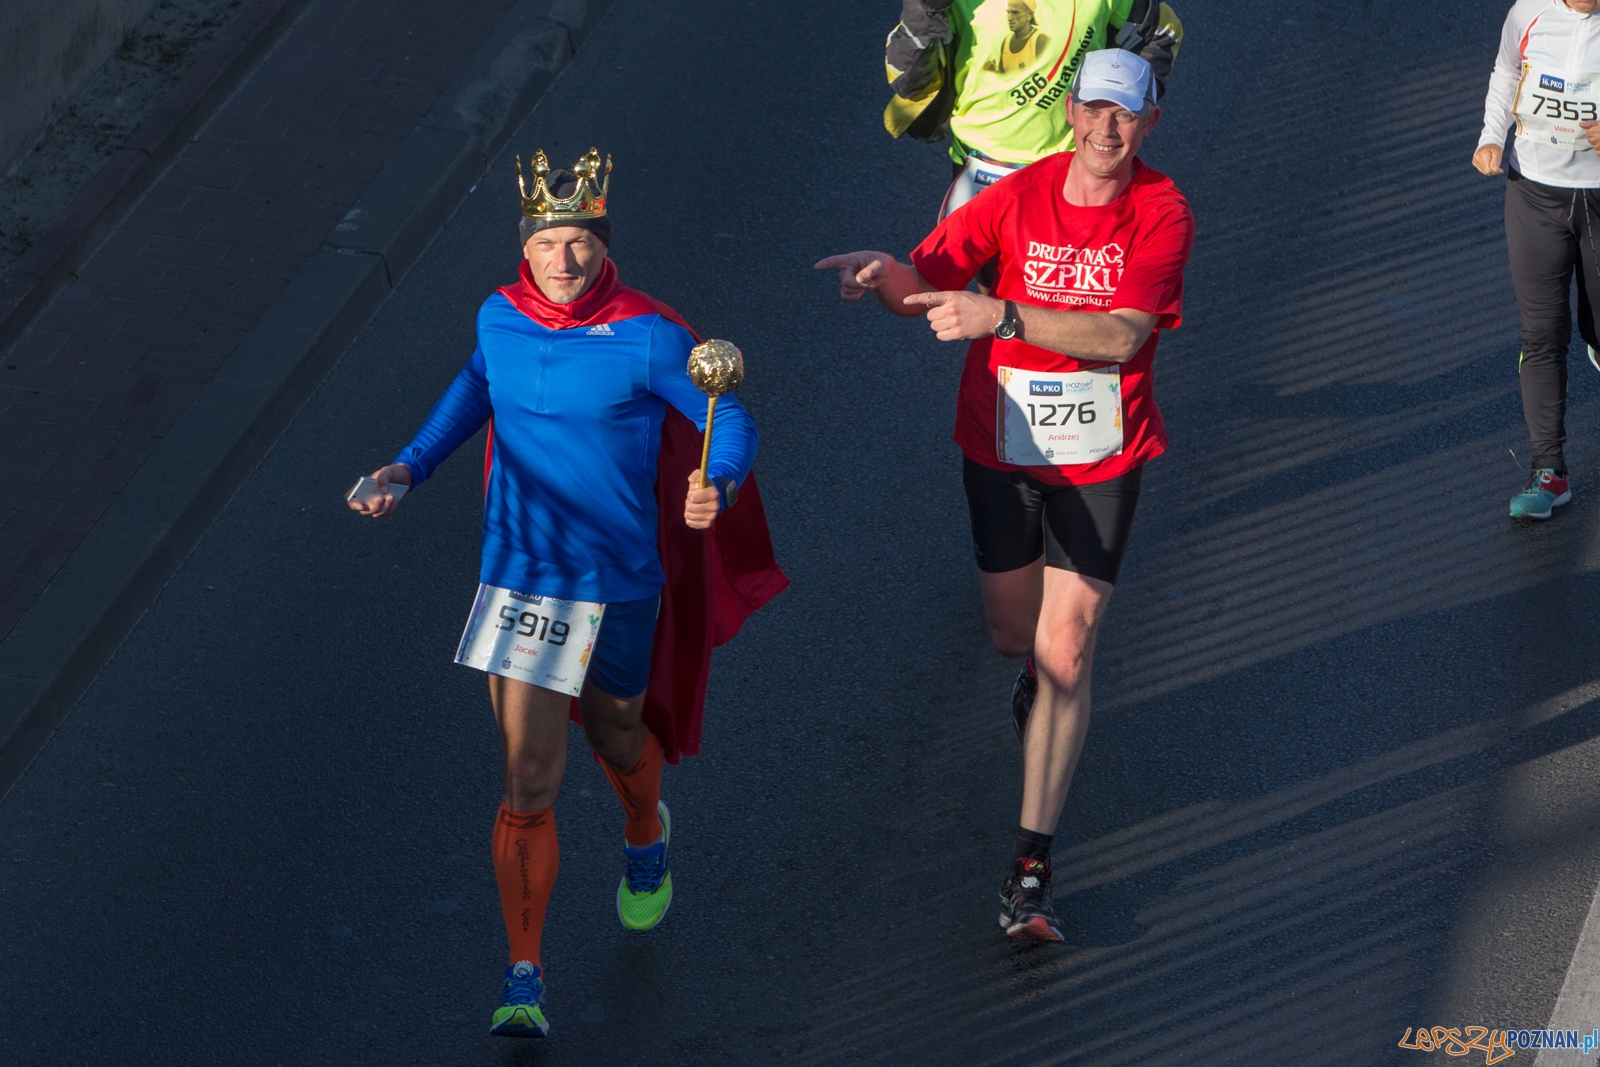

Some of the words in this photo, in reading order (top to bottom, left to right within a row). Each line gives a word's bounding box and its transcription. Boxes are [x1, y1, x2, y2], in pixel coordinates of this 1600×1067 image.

[1035, 26, 1095, 110] maratonów
[1010, 72, 1048, 106] 366
[1532, 93, 1598, 121] 7353
[1554, 125, 1575, 133] Wiera
[1027, 241, 1106, 266] DRUŻYNA
[1023, 260, 1125, 292] SZPIKU
[1027, 401, 1096, 426] 1276
[495, 605, 571, 647] 5919
[513, 644, 539, 657] Jacek
